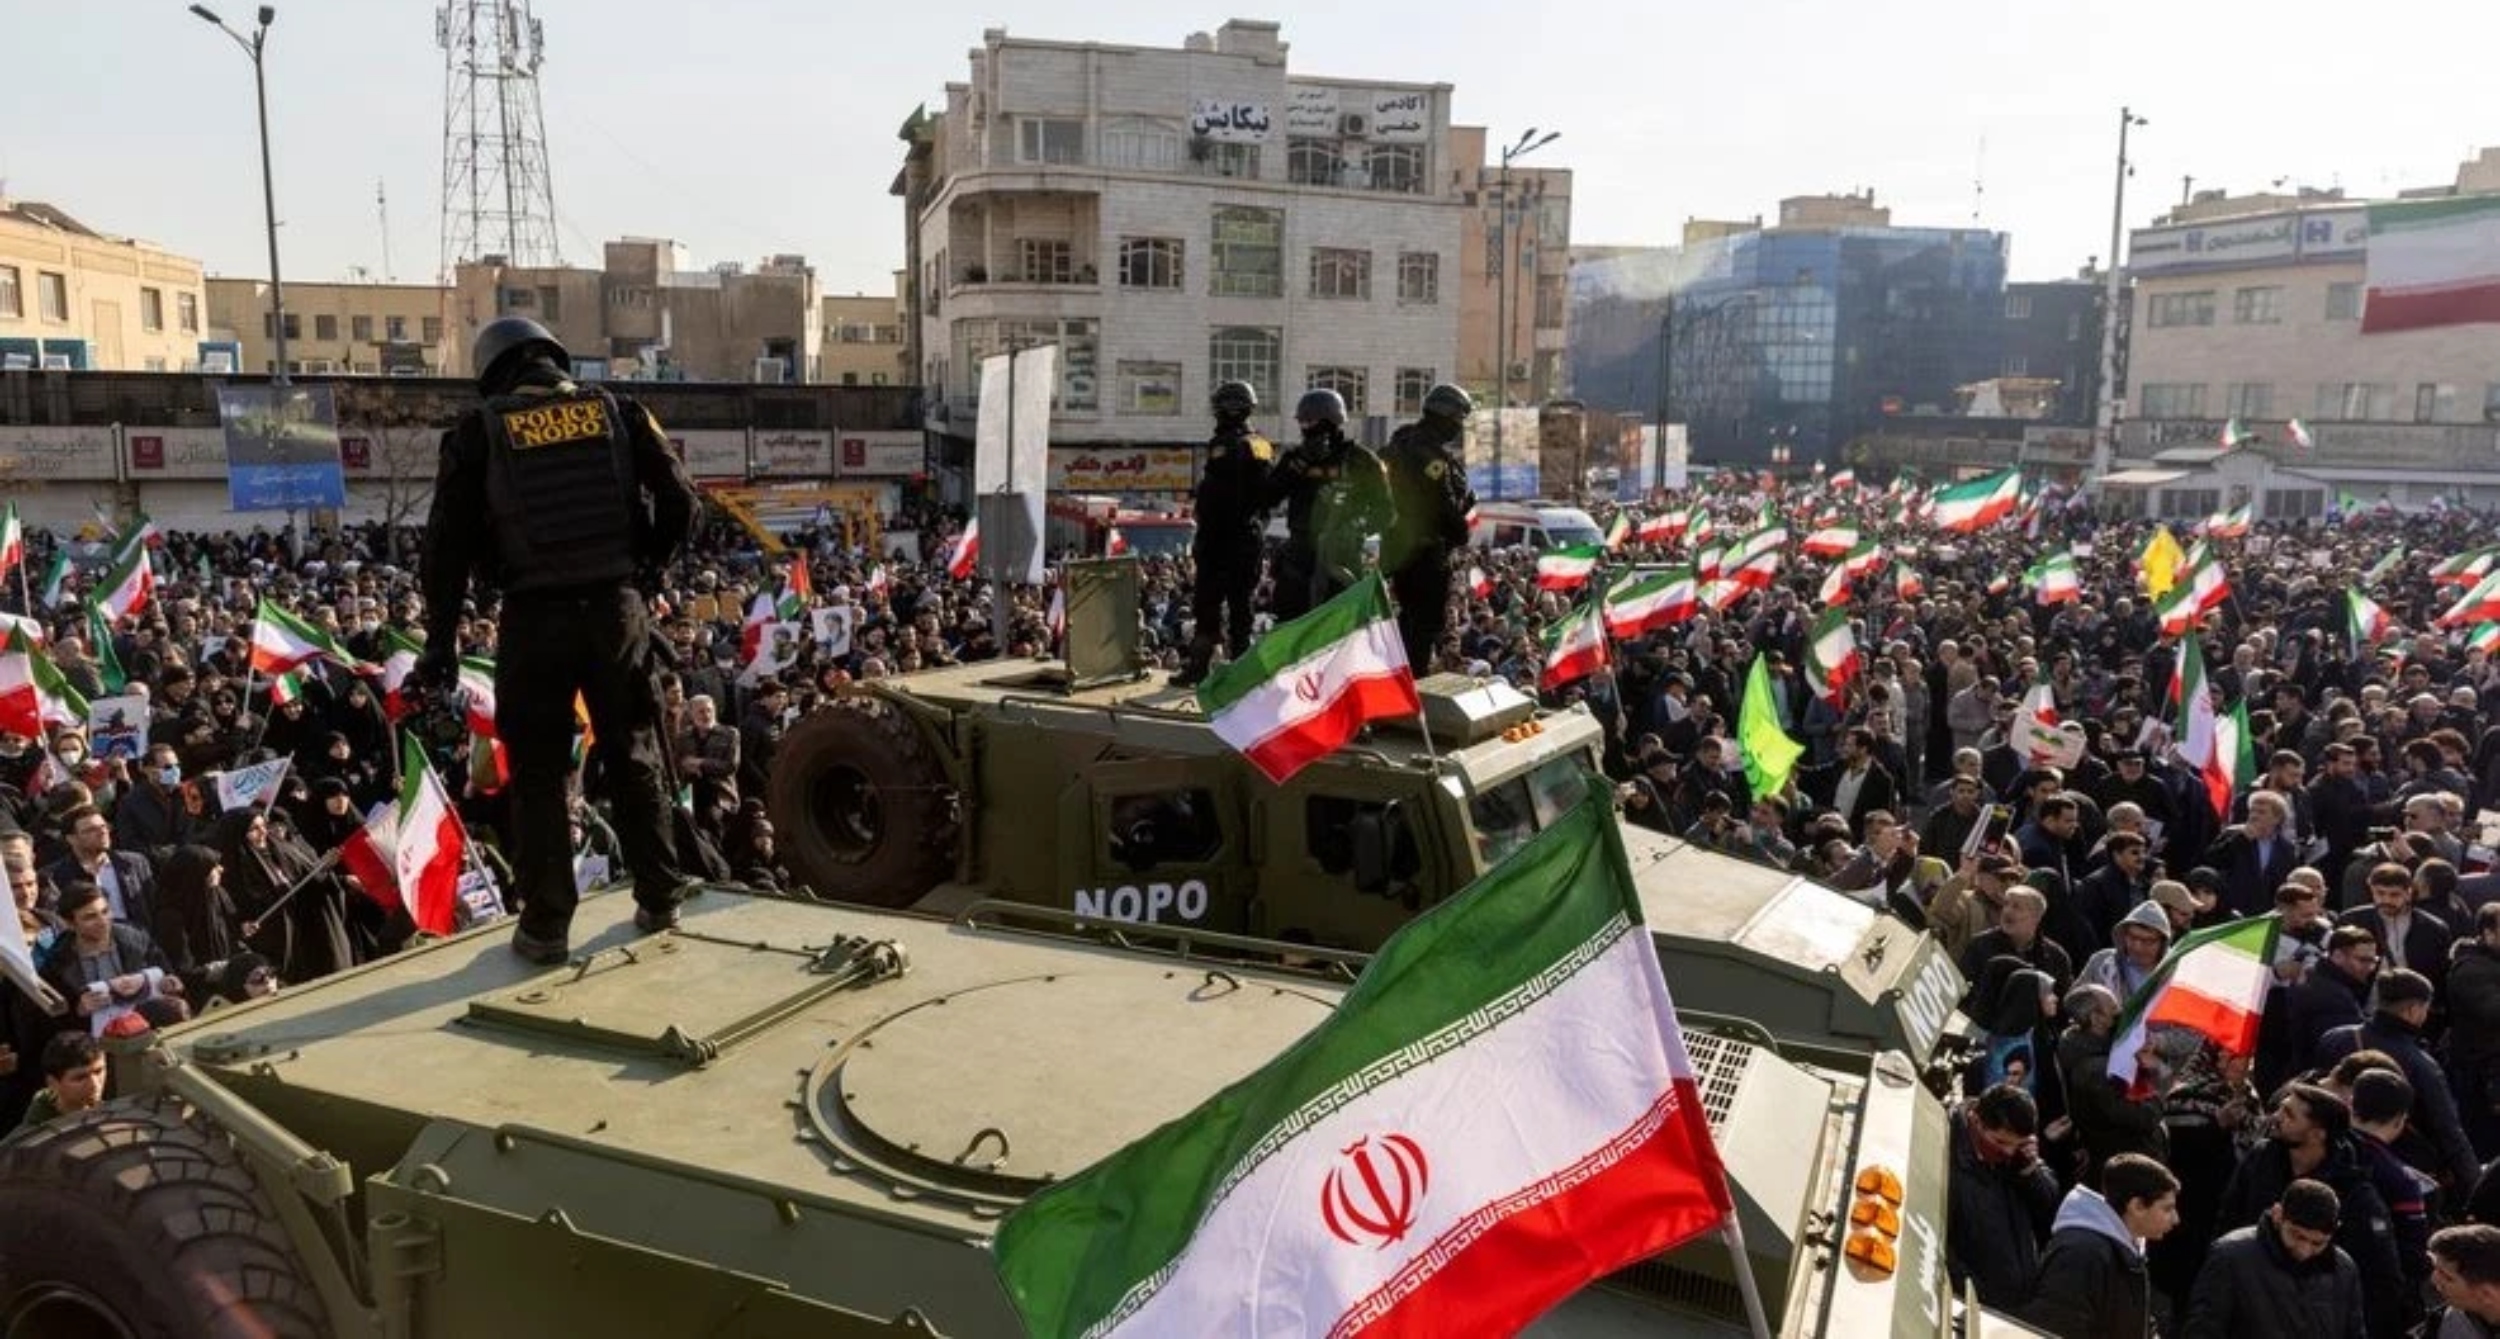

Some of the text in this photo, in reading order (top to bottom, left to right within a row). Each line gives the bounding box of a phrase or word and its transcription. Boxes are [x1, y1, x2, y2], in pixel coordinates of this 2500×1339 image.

[1192, 101, 1269, 138] نیکایش
[508, 401, 603, 433] POLICE
[523, 419, 602, 446] NOPO
[1074, 879, 1208, 924] NOPO
[1901, 952, 1959, 1051] NOPO
